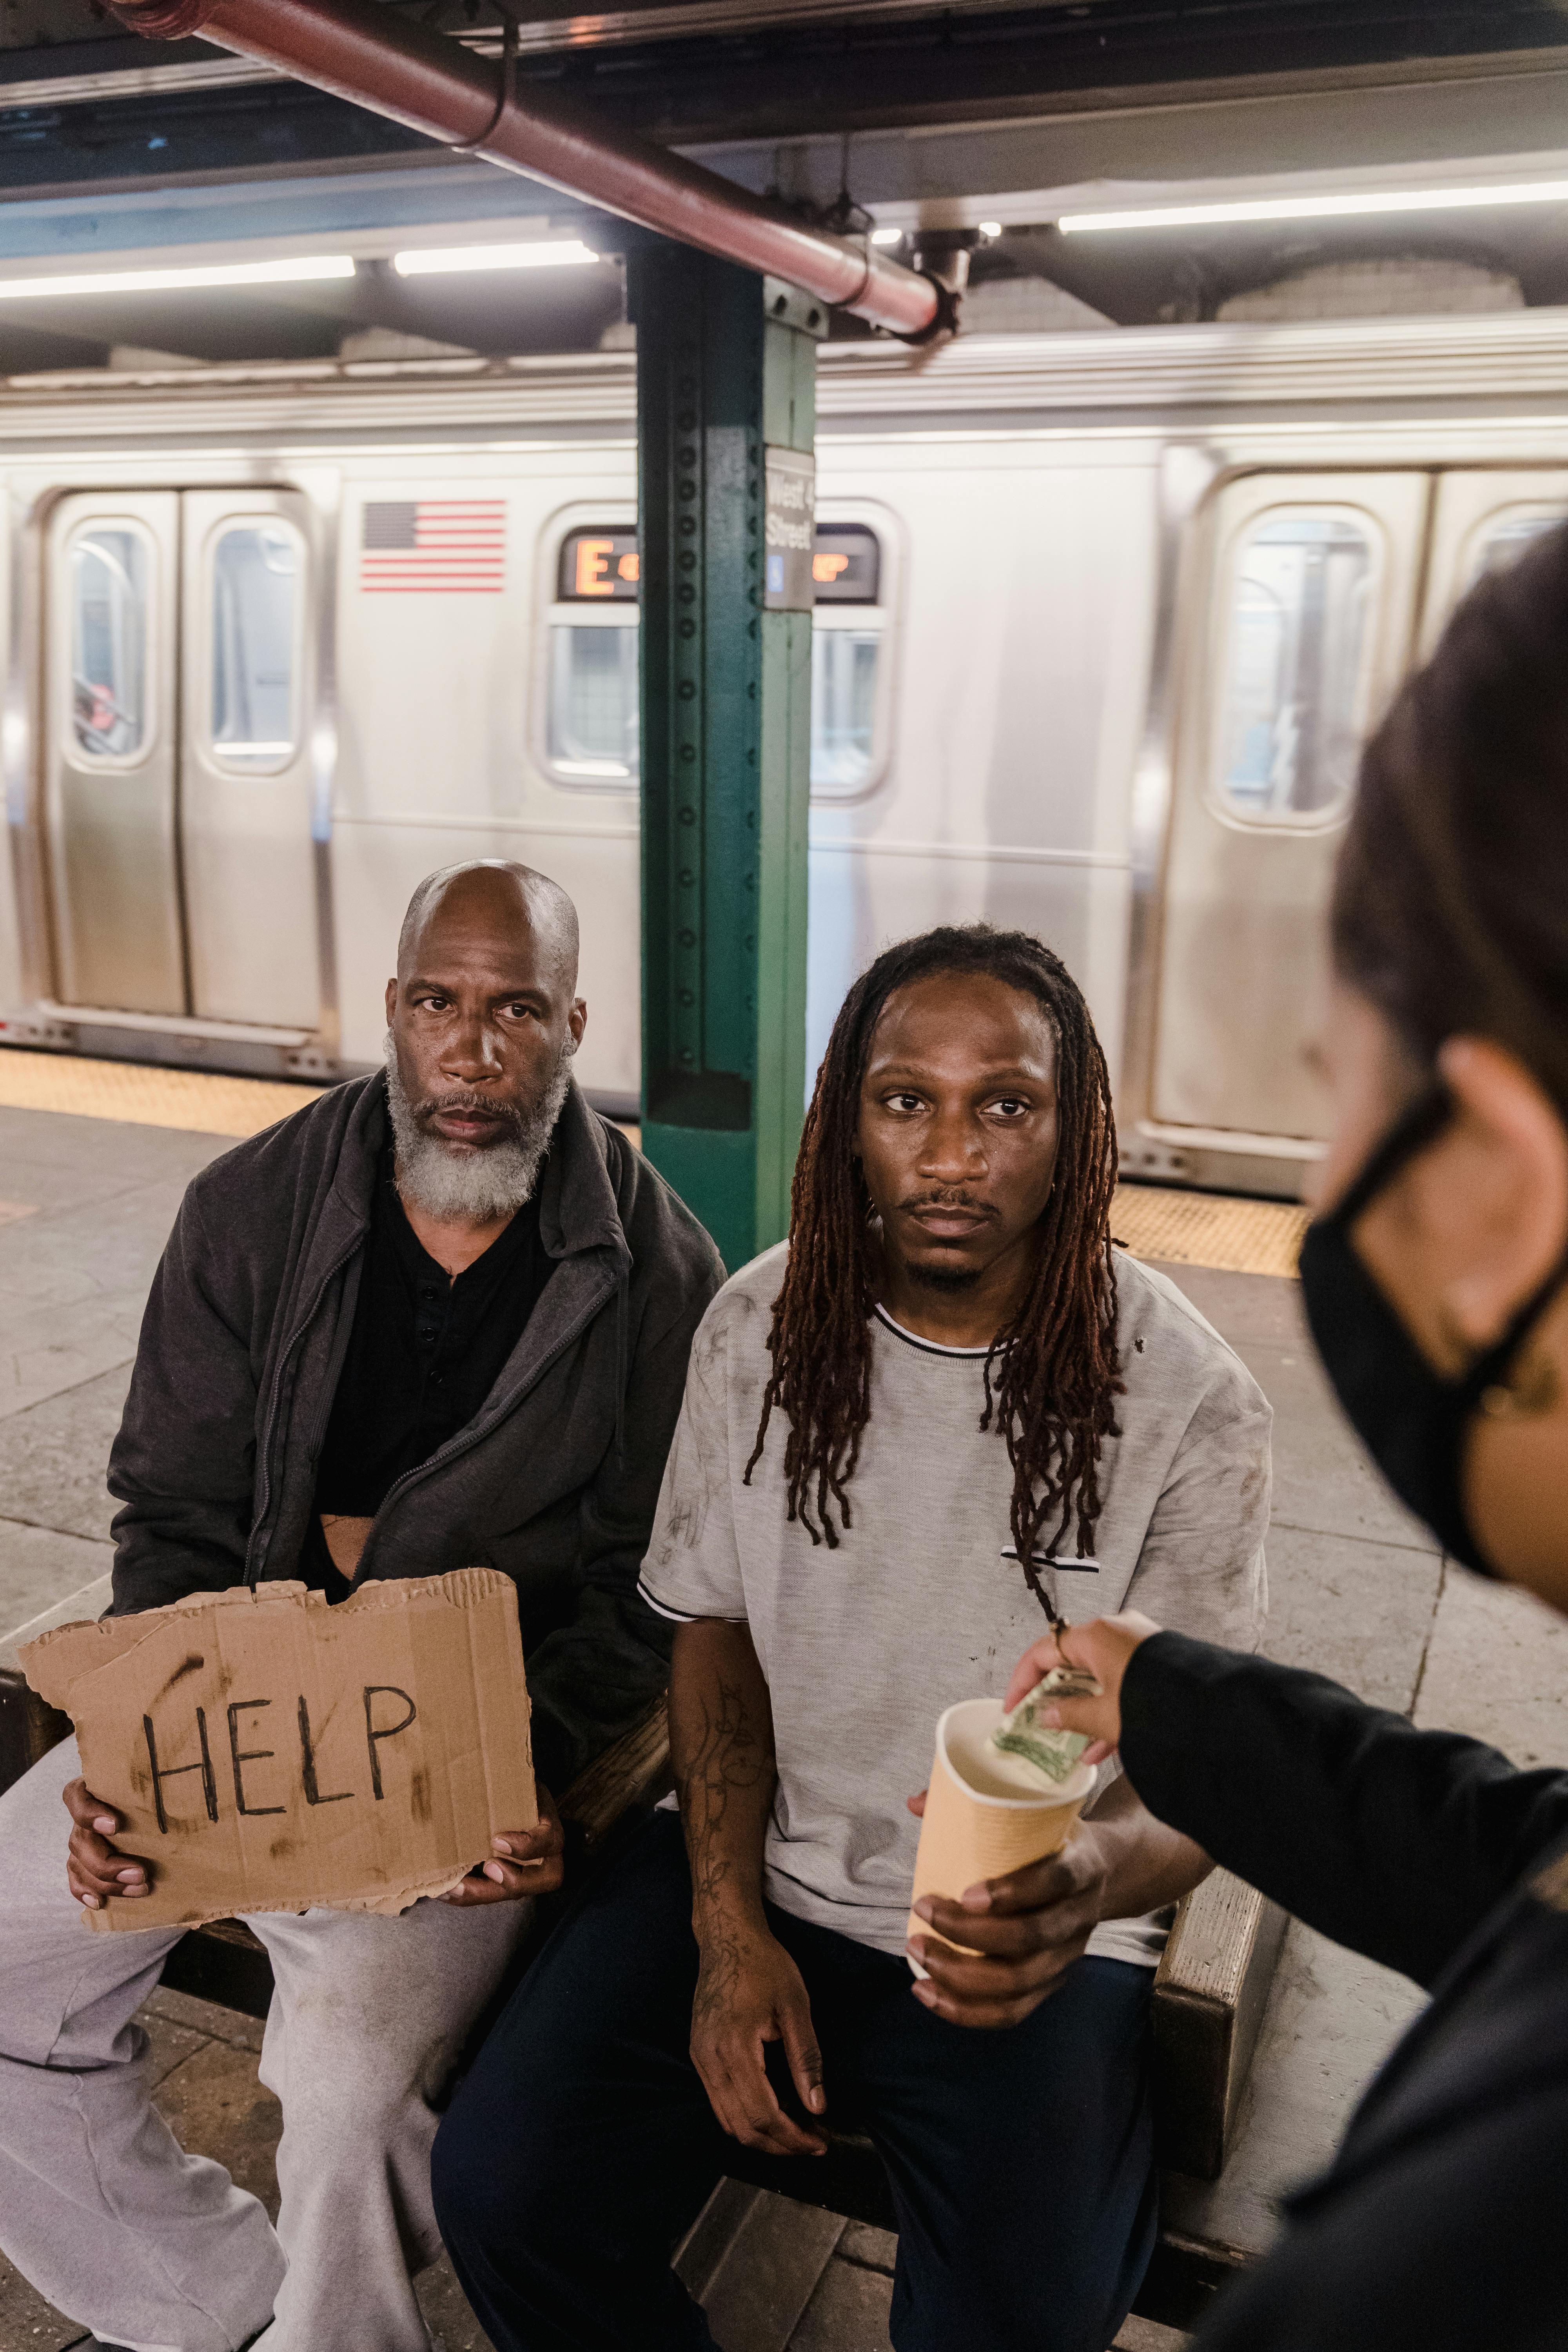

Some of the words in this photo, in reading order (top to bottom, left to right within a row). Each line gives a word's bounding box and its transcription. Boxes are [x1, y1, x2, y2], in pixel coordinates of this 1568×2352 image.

[766, 473, 804, 510] West
[766, 512, 811, 550] Street
[577, 541, 614, 594] E
[143, 1686, 417, 1833] HELP
